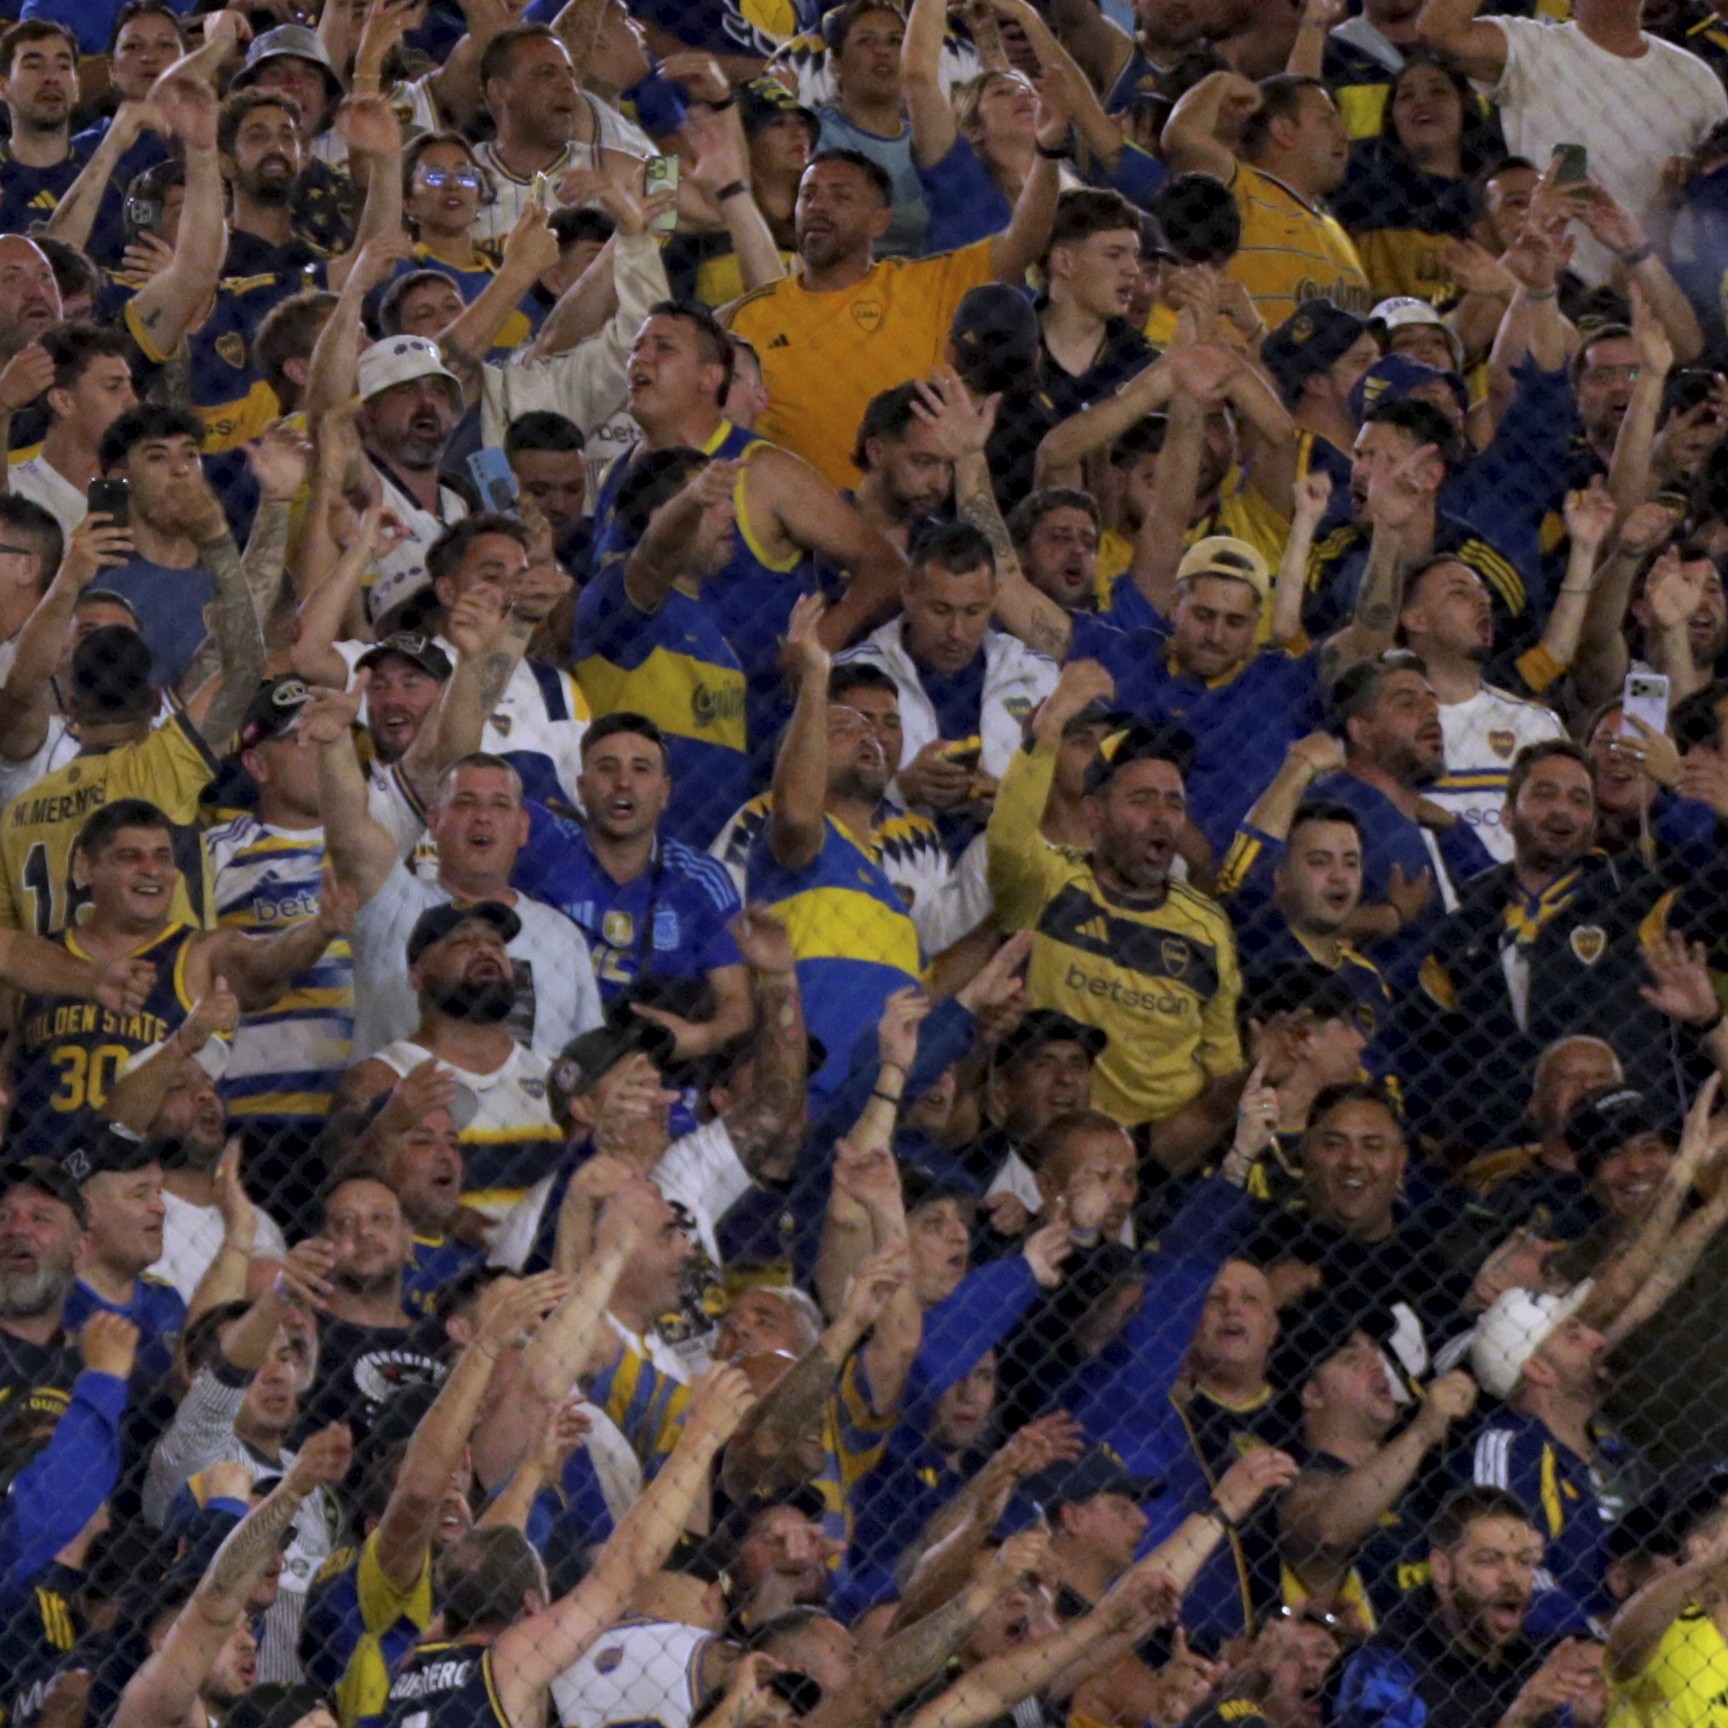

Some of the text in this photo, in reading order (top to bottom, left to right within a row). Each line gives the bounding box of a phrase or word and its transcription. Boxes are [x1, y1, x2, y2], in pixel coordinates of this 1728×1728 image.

[1064, 964, 1190, 1015] betsson
[102, 1009, 168, 1043] STATE
[49, 1046, 126, 1113] 30
